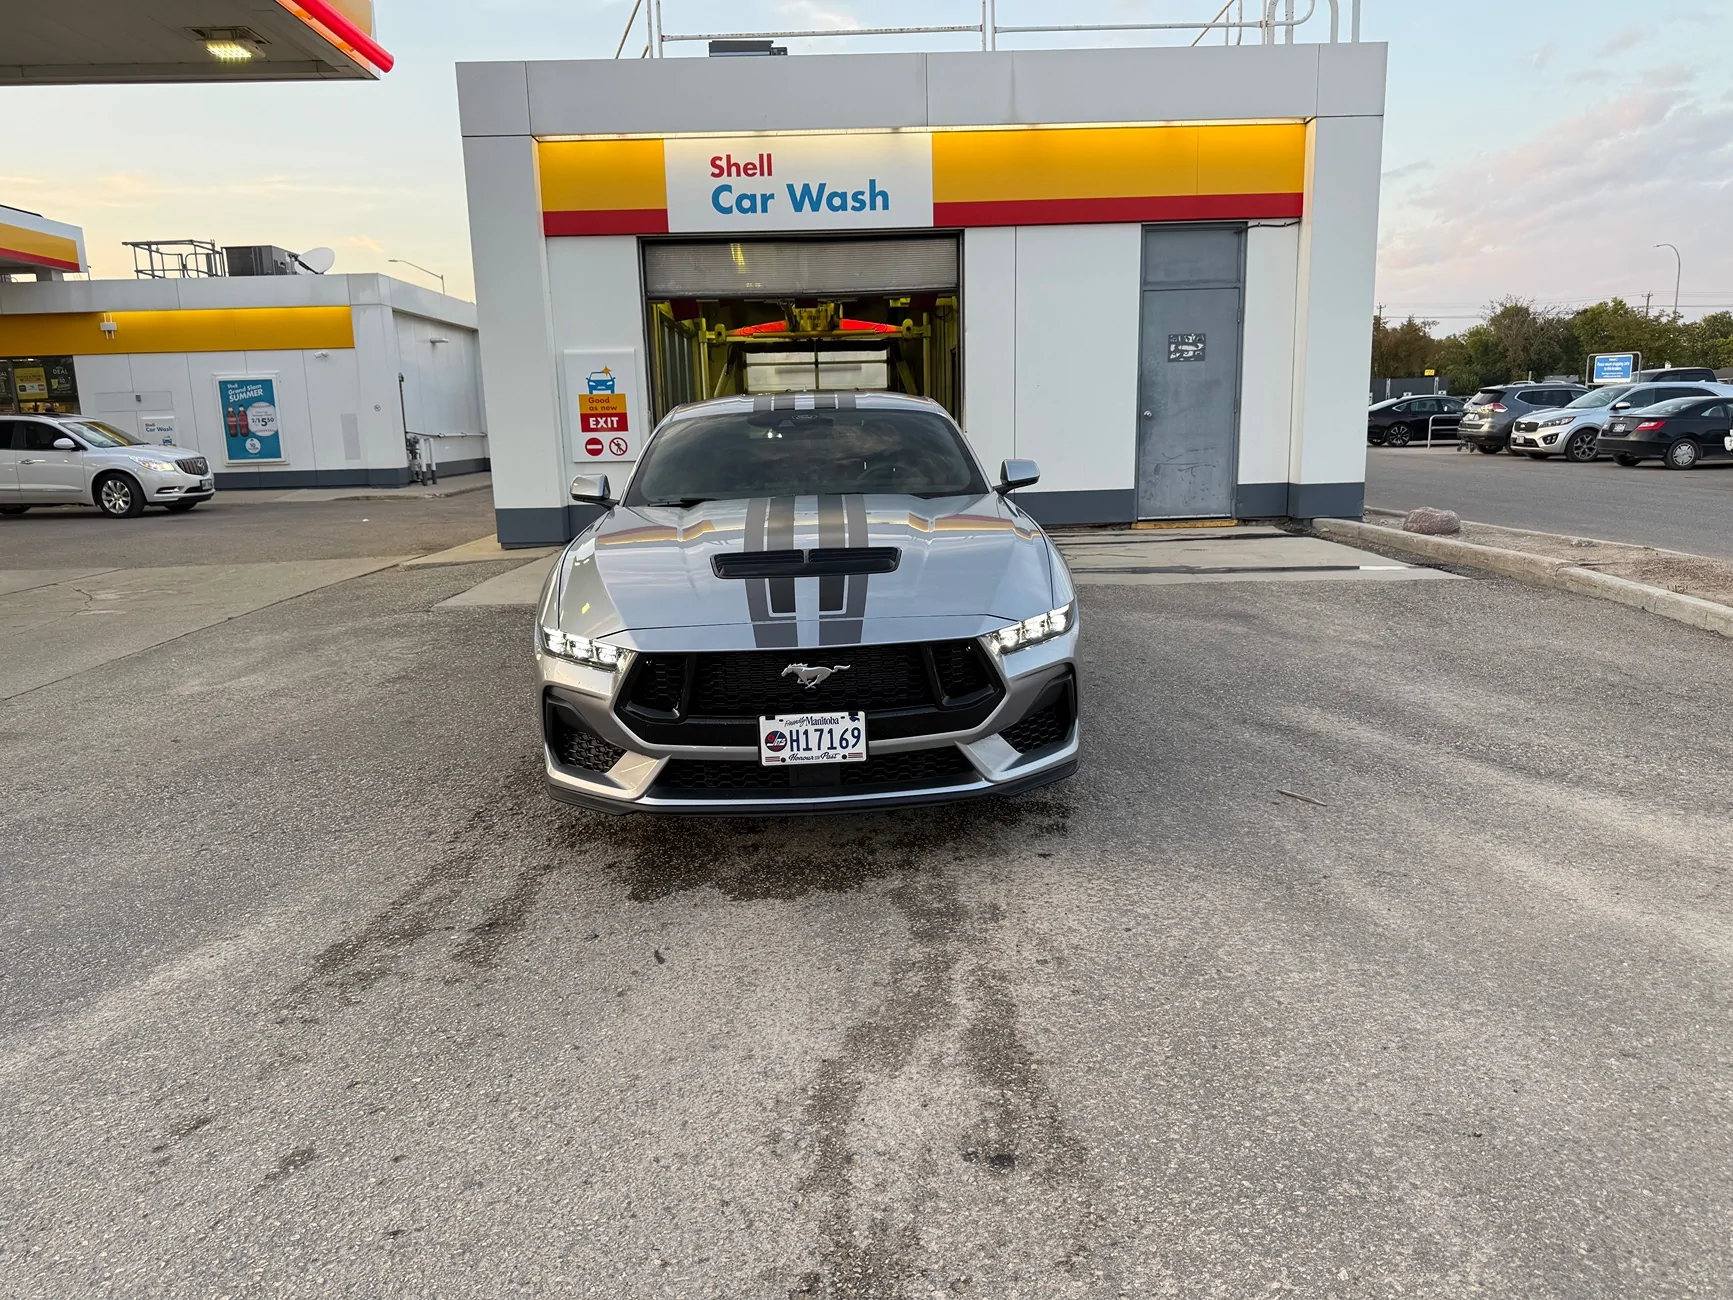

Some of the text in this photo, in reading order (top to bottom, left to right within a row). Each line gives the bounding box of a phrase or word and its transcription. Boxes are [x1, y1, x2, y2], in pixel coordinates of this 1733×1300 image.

[710, 153, 773, 178] Shell
[711, 179, 890, 215] Car Wash
[228, 385, 246, 395] Grand
[229, 388, 263, 402] SUMMER
[589, 417, 619, 428] EXIT
[806, 716, 840, 726] Manitoba
[789, 727, 861, 752] H17169
[788, 753, 814, 762] Honour
[820, 752, 838, 760] Past
